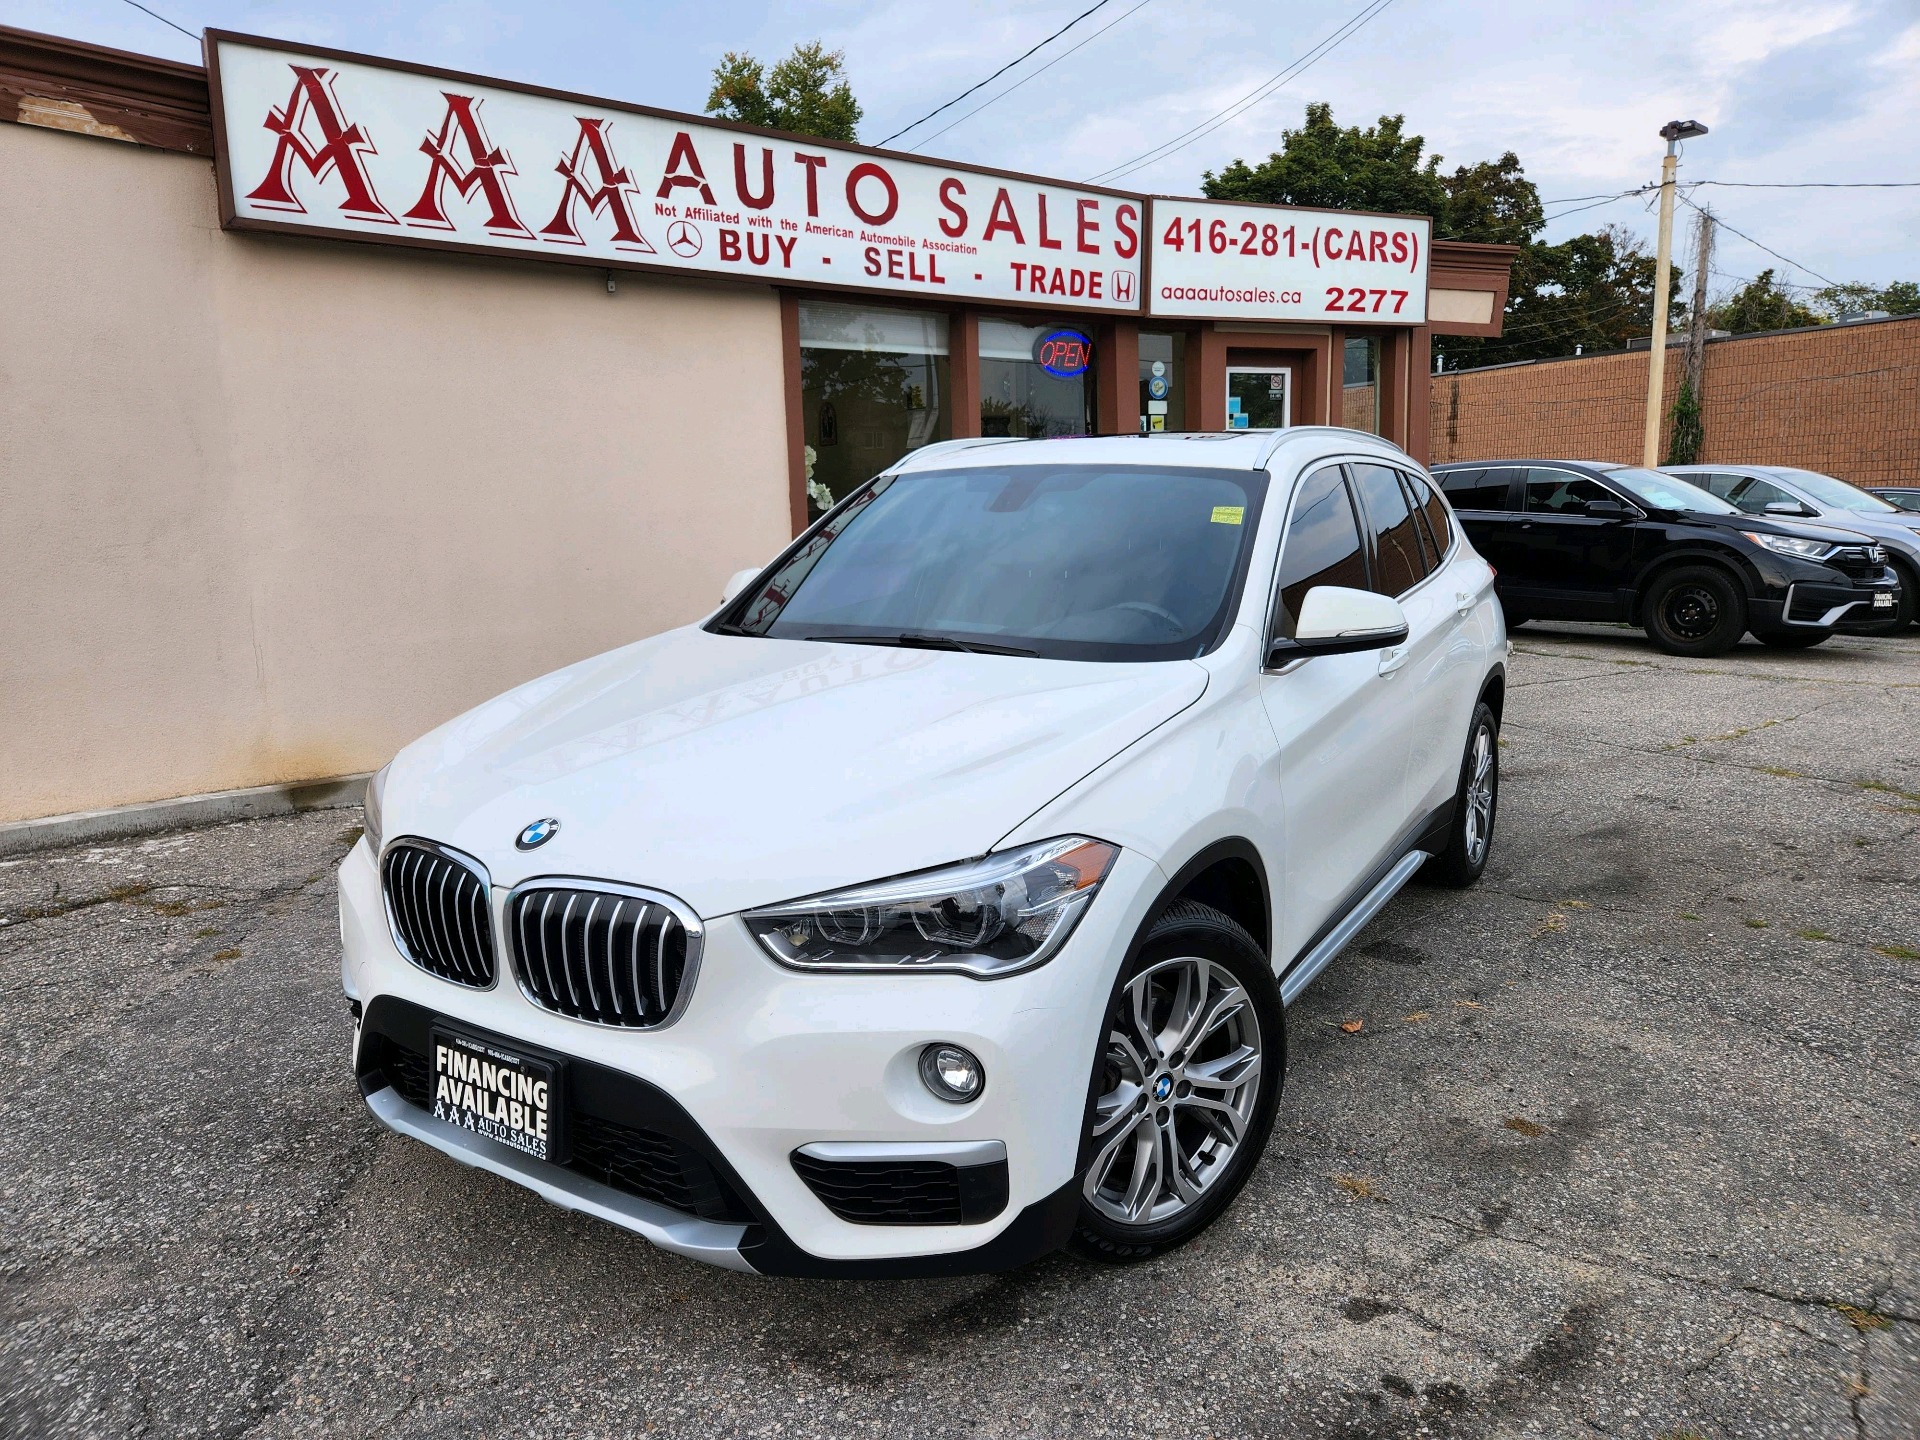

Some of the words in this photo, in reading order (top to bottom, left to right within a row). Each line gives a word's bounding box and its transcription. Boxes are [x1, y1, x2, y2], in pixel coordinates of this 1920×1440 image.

[656, 131, 899, 227] AUTO
[938, 177, 1138, 260] SALES
[655, 202, 677, 218] Not
[685, 206, 740, 225] Affiliated
[748, 216, 773, 229] with
[780, 218, 798, 232] the
[805, 221, 854, 239] American
[859, 230, 916, 248] Automobile
[922, 238, 977, 255] Association
[1163, 216, 1419, 274] 416-281-(CARS)
[719, 228, 798, 269] BUY
[863, 246, 946, 285] SELL
[1010, 261, 1103, 300] TRADE
[1161, 285, 1302, 304] aaaautosales.ca
[1325, 286, 1409, 314] 2277
[1040, 341, 1092, 367] OPEN
[436, 1044, 548, 1111] FINANCING
[436, 1075, 548, 1142] AVAILABLE
[477, 1117, 507, 1139] AUTO
[510, 1128, 547, 1154] SALES
